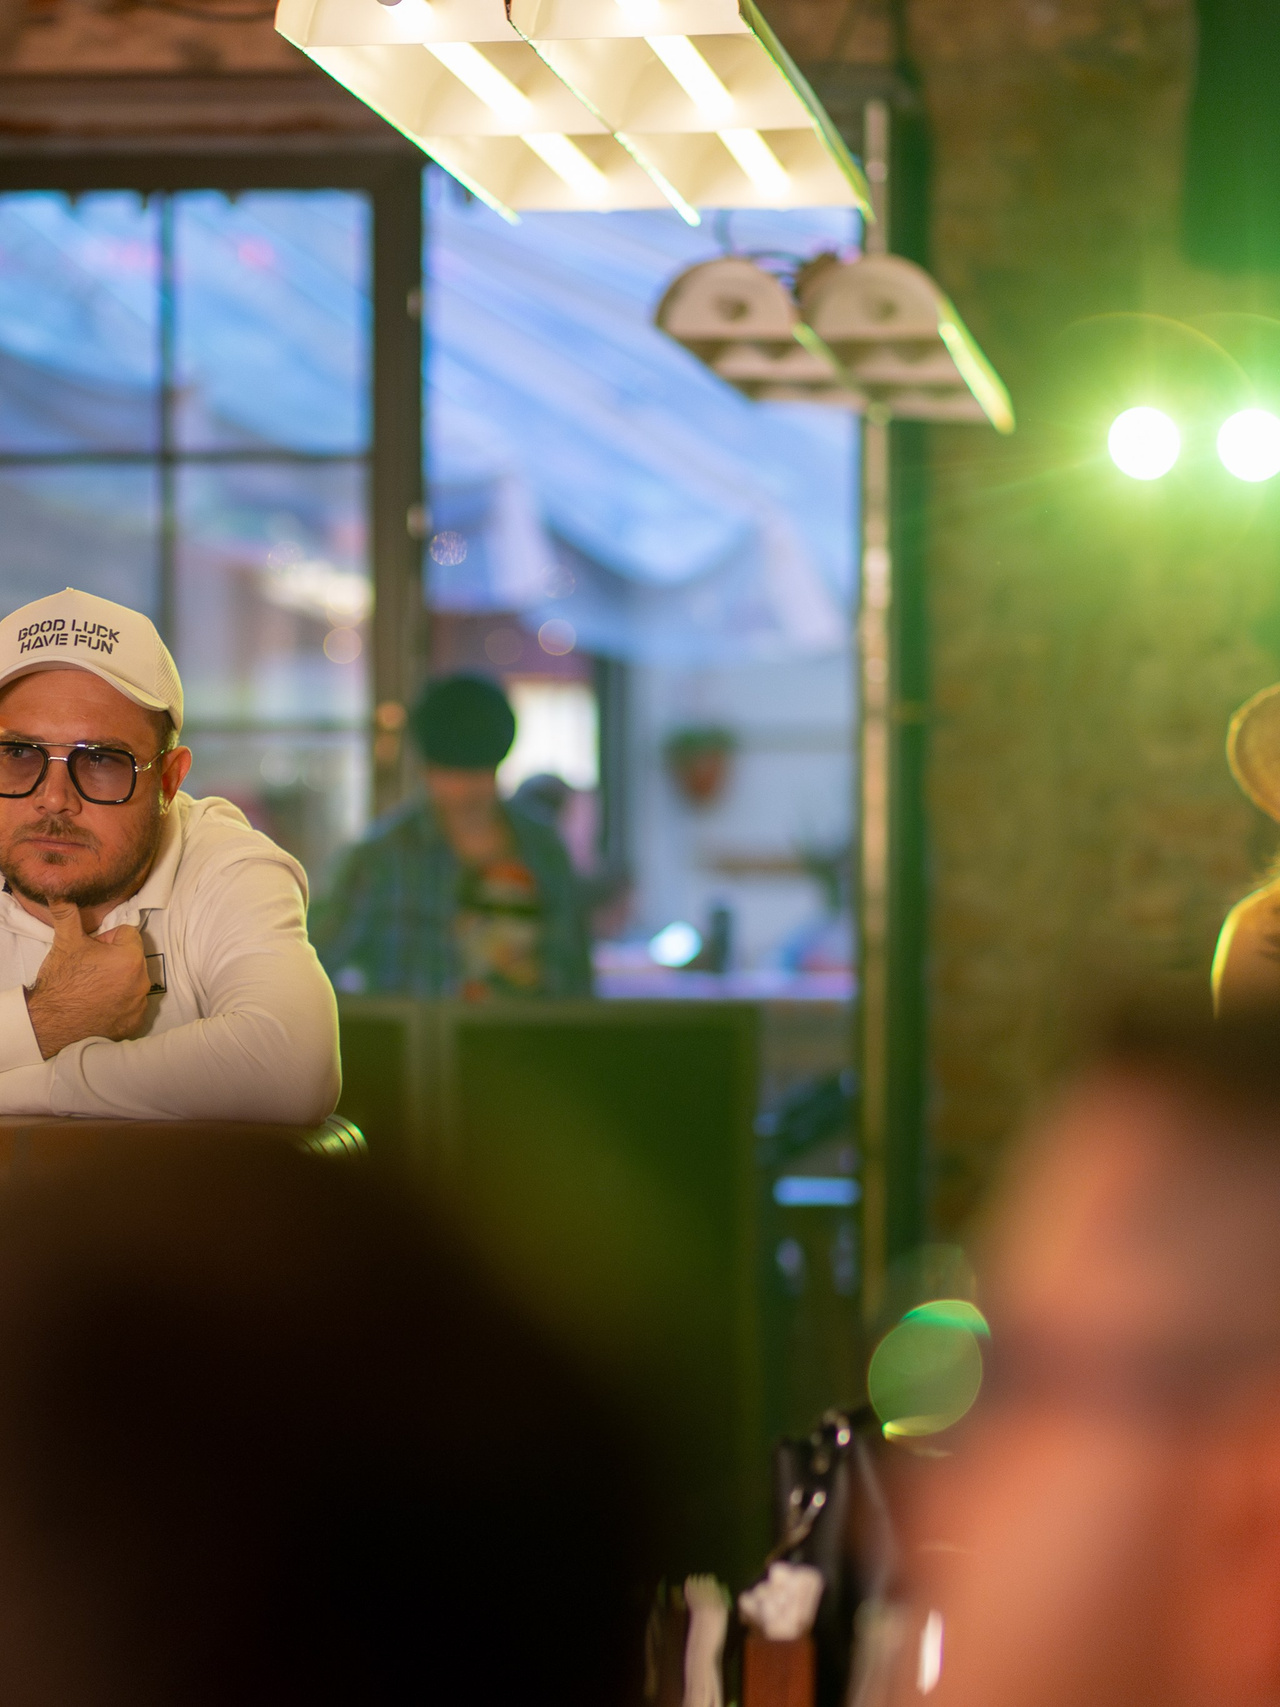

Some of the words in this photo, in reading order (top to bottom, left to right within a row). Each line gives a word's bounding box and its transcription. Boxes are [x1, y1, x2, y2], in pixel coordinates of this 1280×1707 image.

[17, 619, 65, 642] GOOD
[71, 619, 120, 643] LUCK
[20, 633, 69, 653] HAVE
[74, 634, 114, 655] FUN
